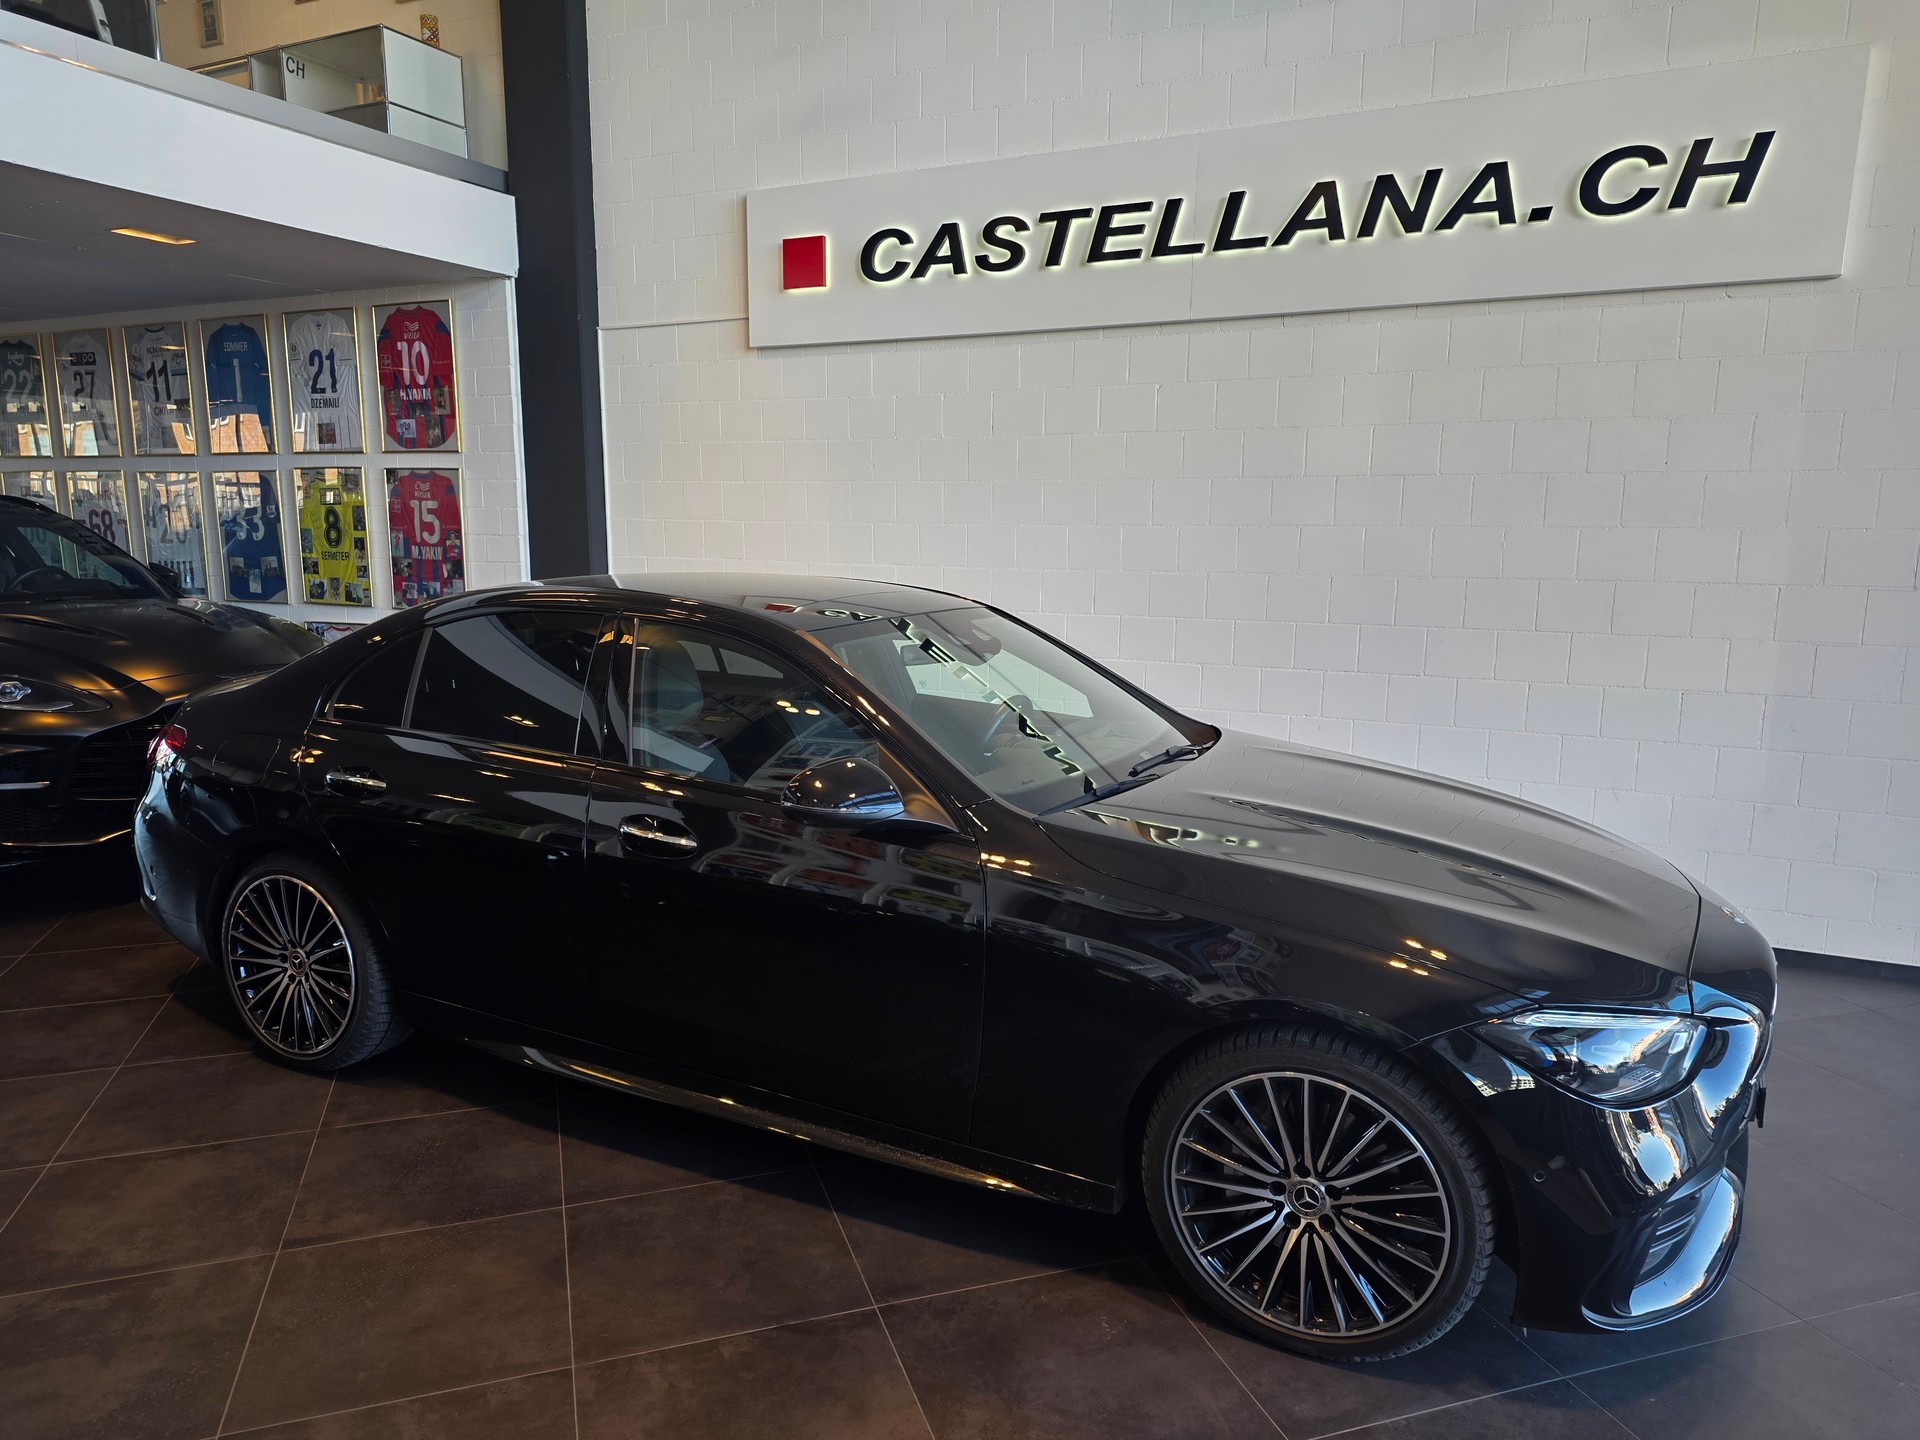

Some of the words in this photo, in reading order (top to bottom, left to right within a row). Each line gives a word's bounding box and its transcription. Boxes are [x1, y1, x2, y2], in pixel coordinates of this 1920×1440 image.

[285, 56, 305, 79] CH
[860, 130, 1777, 282] CASTELLANA.CH
[223, 341, 248, 352] SOMMER
[396, 340, 430, 386] 10
[3, 369, 33, 405] 22
[73, 369, 96, 408] 27
[146, 360, 172, 402] 11
[234, 358, 243, 402] 1
[308, 348, 338, 395] 21
[310, 396, 340, 409] DZEMAILI
[399, 387, 432, 401] H.YAKIN
[88, 508, 116, 543] 68
[324, 506, 342, 548] 8
[409, 499, 441, 544] 15
[320, 550, 350, 561] SERMETER
[411, 545, 443, 560] M.YAKIN
